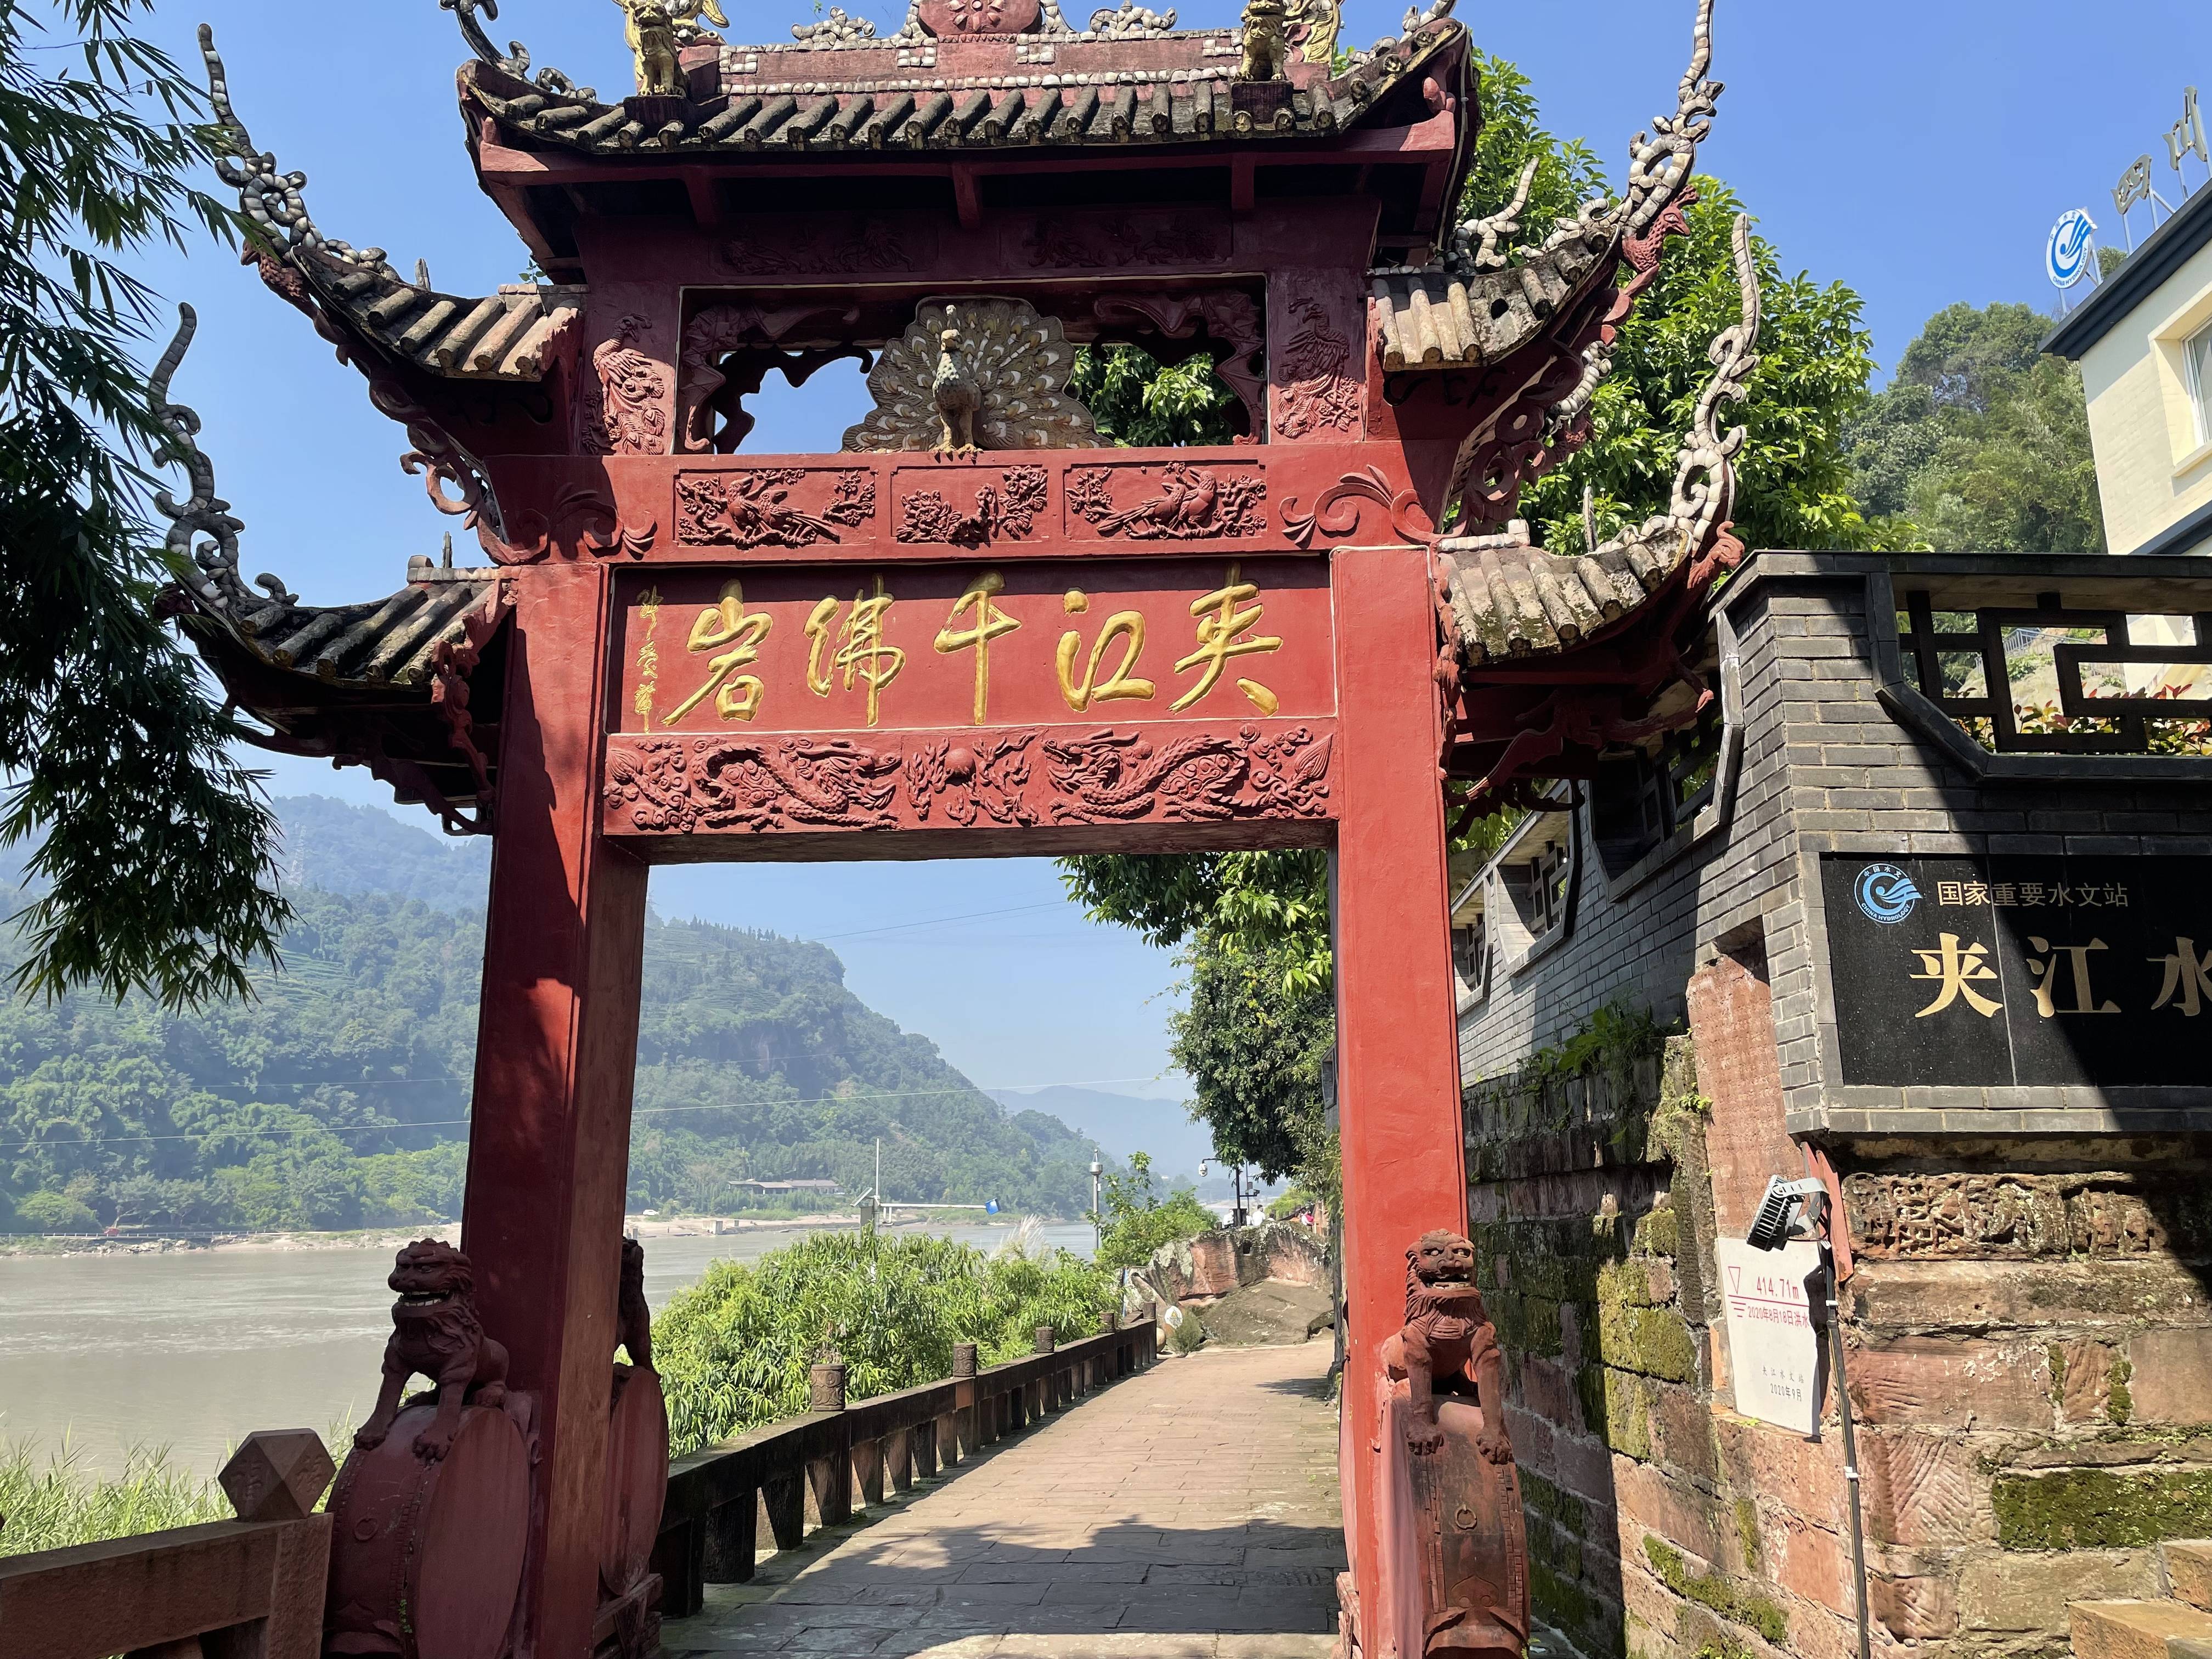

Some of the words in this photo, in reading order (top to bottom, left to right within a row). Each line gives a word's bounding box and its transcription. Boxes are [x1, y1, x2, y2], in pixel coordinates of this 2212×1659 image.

[2052, 276, 2065, 286] CHINA
[2065, 247, 2087, 285] HYDROLOGY
[1863, 865, 1902, 878] 中国水文
[1937, 880, 2129, 907] 国家重要水文站
[1860, 902, 1877, 918] CHINA
[1878, 903, 1911, 921] HYDROLOGY
[1909, 932, 2212, 1019] 夹江水
[1757, 1276, 1799, 1300] 414.71m
[1747, 1306, 1810, 1328] 2020年8月18日洪水
[1770, 1383, 1802, 1402] 2020年9月
